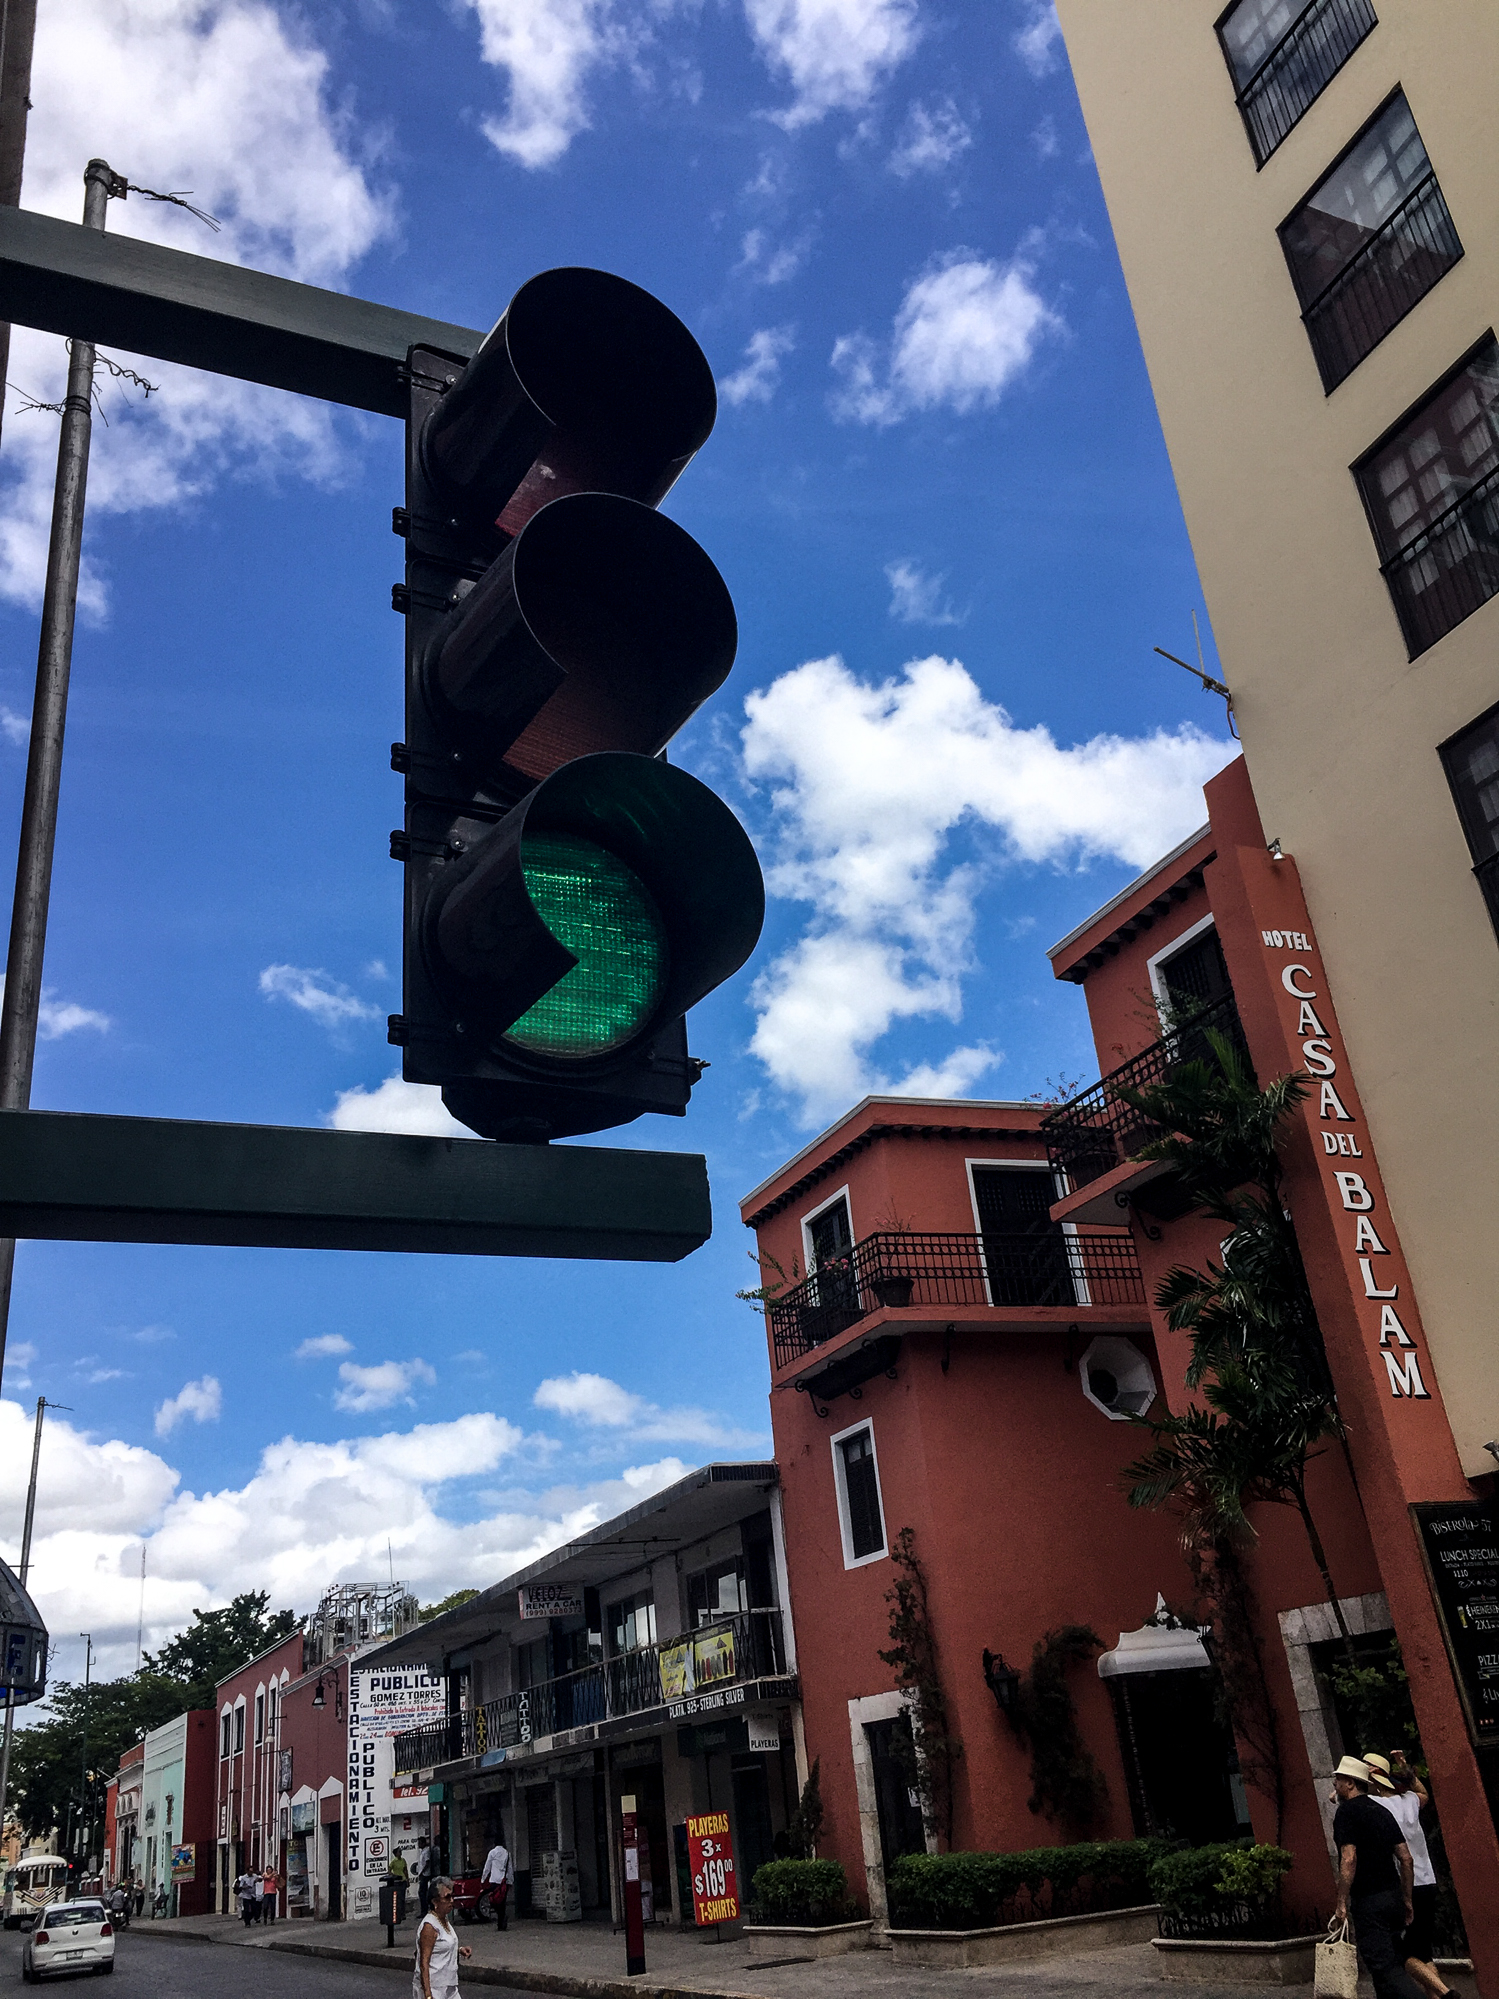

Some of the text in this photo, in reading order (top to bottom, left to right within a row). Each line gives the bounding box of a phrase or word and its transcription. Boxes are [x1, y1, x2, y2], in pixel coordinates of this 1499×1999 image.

[1261, 930, 1312, 952] HOTEL
[1281, 964, 1352, 1121] CASA
[1320, 1132, 1362, 1157] DEL
[1333, 1171, 1431, 1399] BALAM
[1440, 1549, 1469, 1562] LUNCH
[526, 1602, 551, 1610] RENT
[562, 1599, 582, 1607] CAR
[528, 1585, 573, 1602] VELOZ
[370, 1674, 441, 1692] PUBLICO
[370, 1689, 441, 1703] GOMEZ TORRES
[725, 1688, 745, 1705] SILVER
[519, 1691, 532, 1743] TATTOO
[475, 1706, 486, 1755] TATTOO
[750, 1740, 780, 1749] PLAYERAS
[350, 1676, 360, 1872] ESTACIONAMIENTO
[362, 1742, 375, 1829] PUBLICO
[374, 1825, 380, 1833] 3
[688, 1813, 729, 1838] PLAYERAS
[701, 1838, 714, 1857] 3
[699, 1897, 737, 1922] T-SHIRTS
